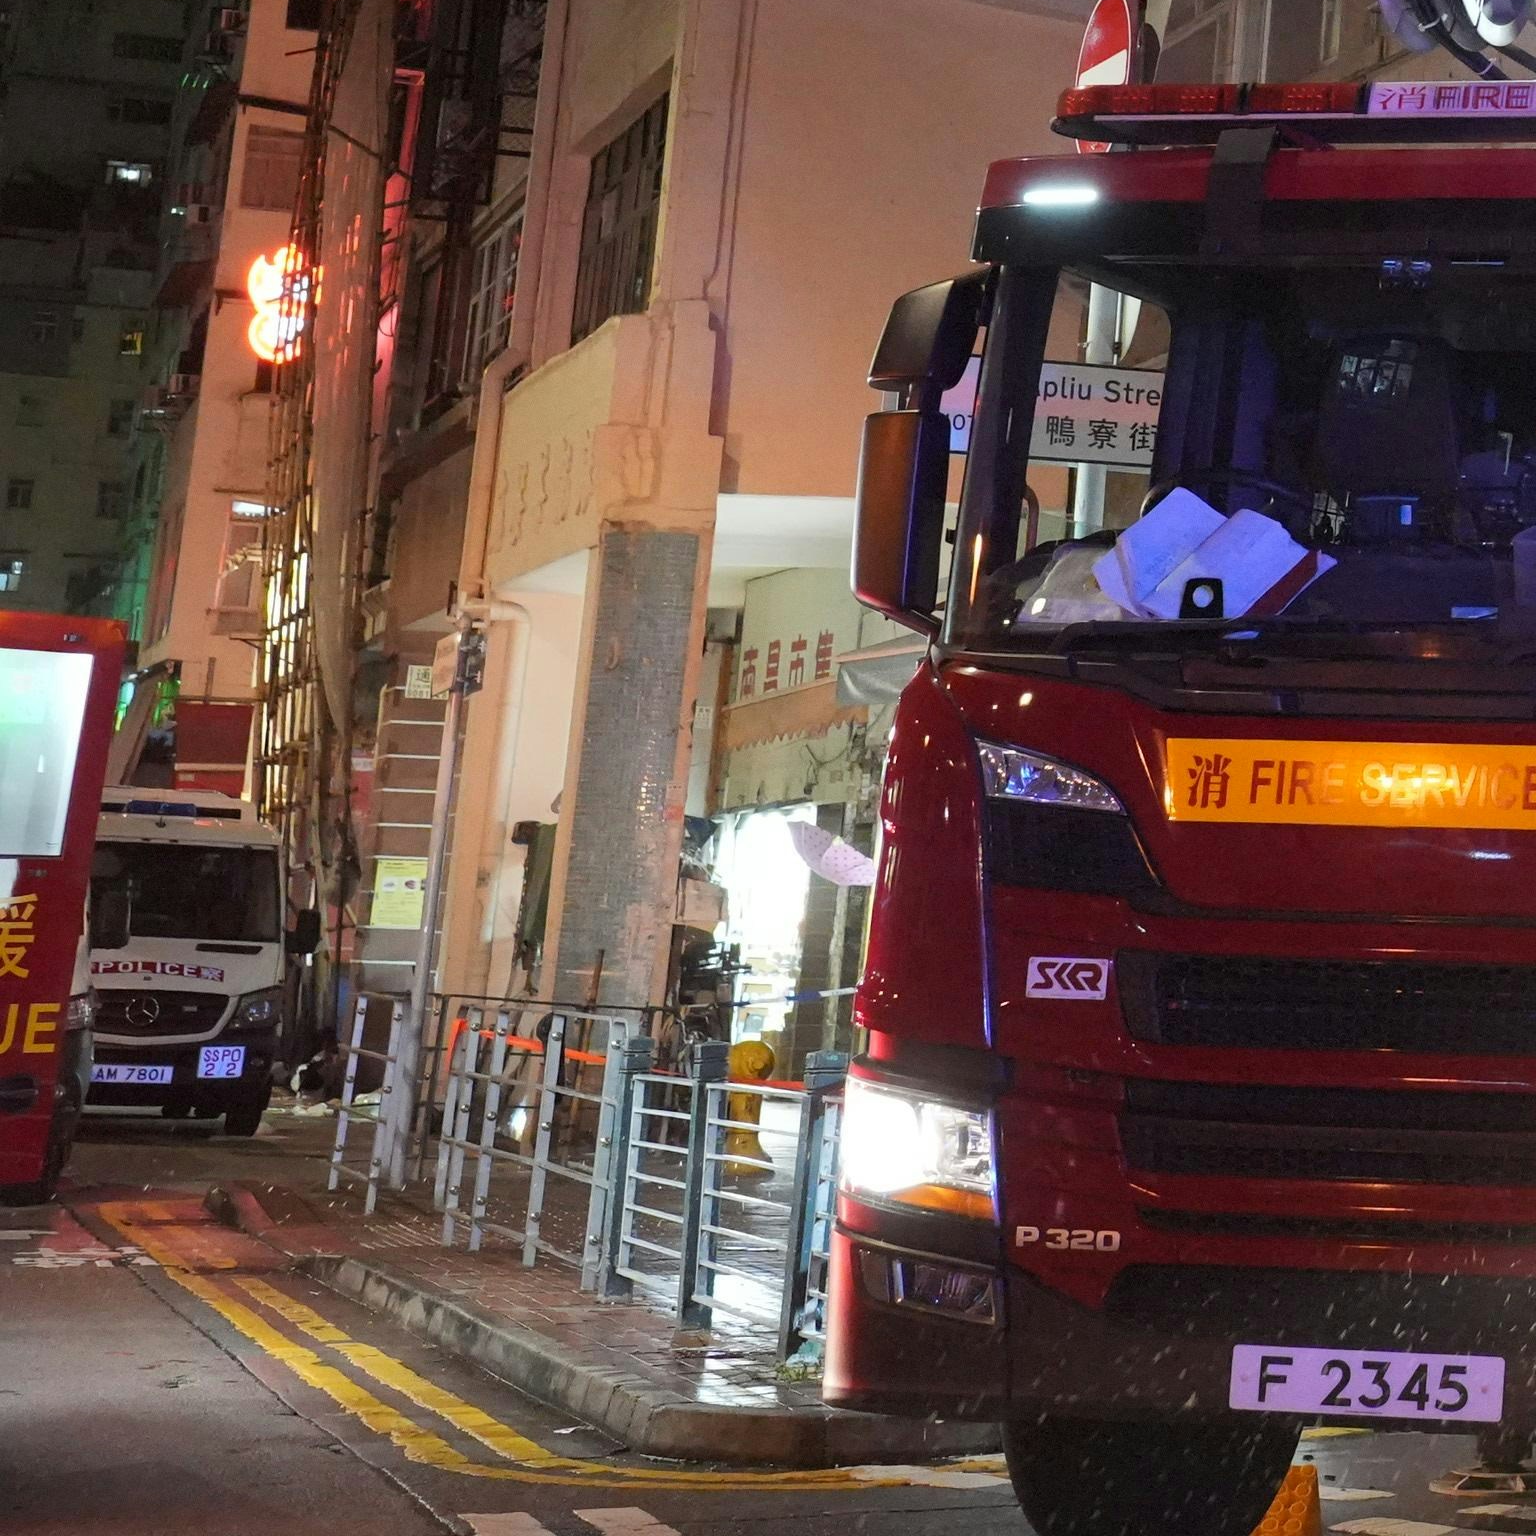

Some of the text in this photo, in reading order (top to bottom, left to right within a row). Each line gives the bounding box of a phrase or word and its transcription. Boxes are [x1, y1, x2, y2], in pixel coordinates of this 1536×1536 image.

[1436, 85, 1530, 110] FIRE
[1037, 375, 1161, 407] pliu Stre
[1187, 754, 1231, 810] 消
[1249, 760, 1345, 808] FIRE
[99, 962, 198, 978] POLICE
[95, 1066, 165, 1082] AM 7801
[1258, 1355, 1470, 1413] F 2345
